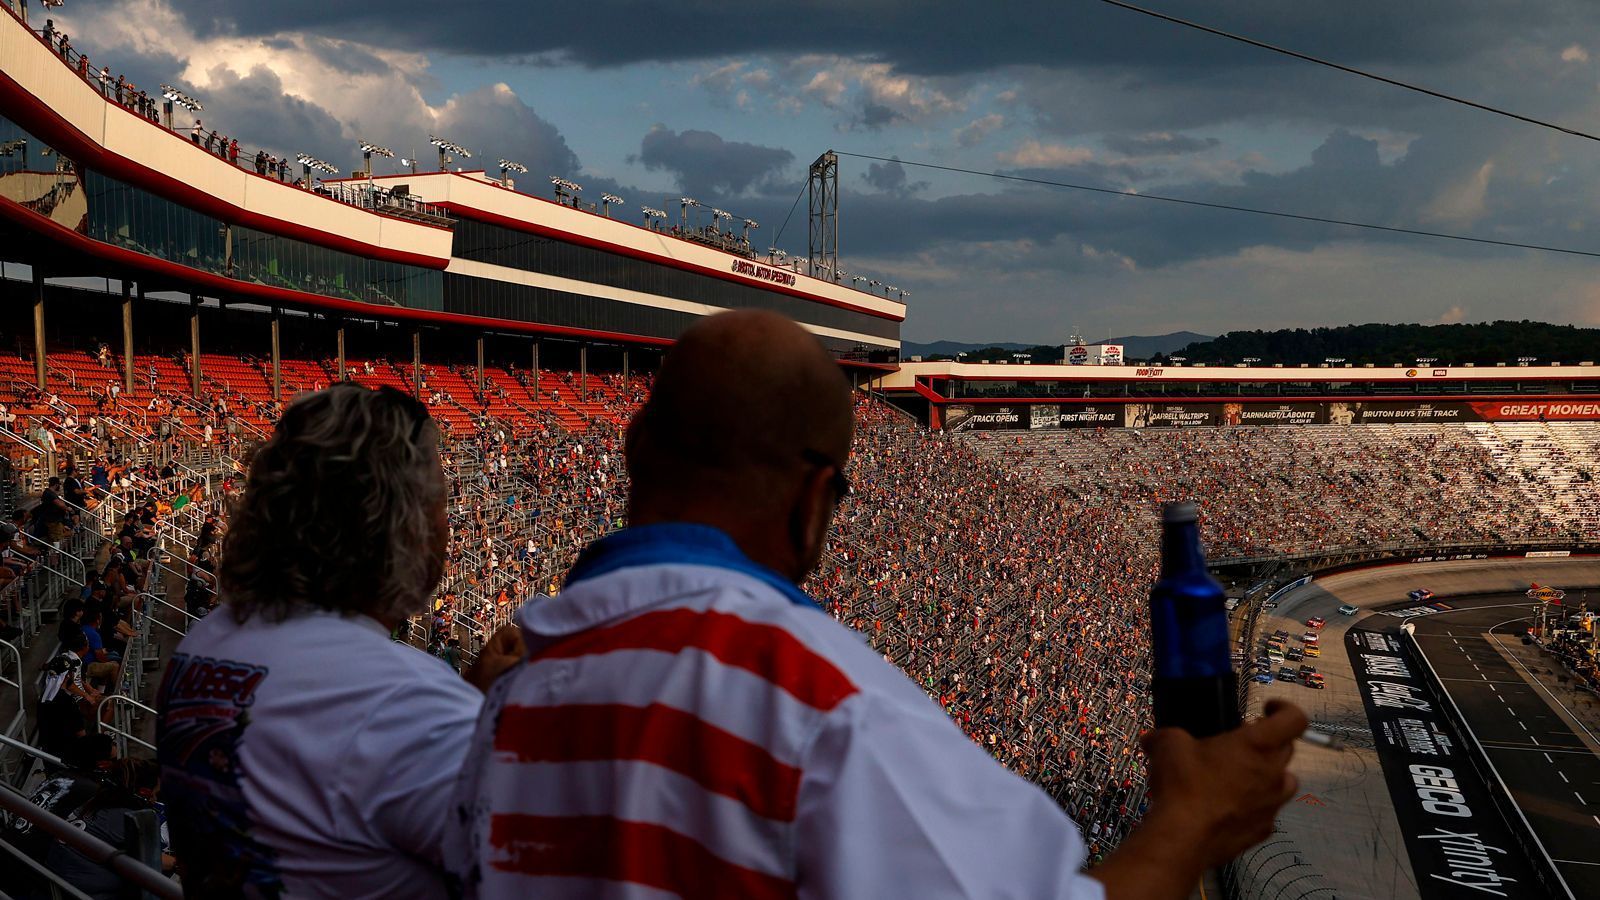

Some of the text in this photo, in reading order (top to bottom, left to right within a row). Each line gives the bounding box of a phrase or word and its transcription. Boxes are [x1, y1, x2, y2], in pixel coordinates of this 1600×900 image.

[1136, 368, 1164, 376] FOOD CITY
[1362, 410, 1394, 418] BRUTON
[1433, 409, 1459, 417] TRACK
[1500, 405, 1547, 416] GREAT
[973, 414, 1019, 423] TRACK OPENS
[1060, 414, 1078, 422] FIRST
[1078, 413, 1099, 422] NIGHT
[1098, 413, 1116, 421] RACE
[1179, 412, 1210, 420] WALTRIP'S
[1408, 764, 1473, 818] GEICO
[1417, 827, 1519, 897] xfinity
